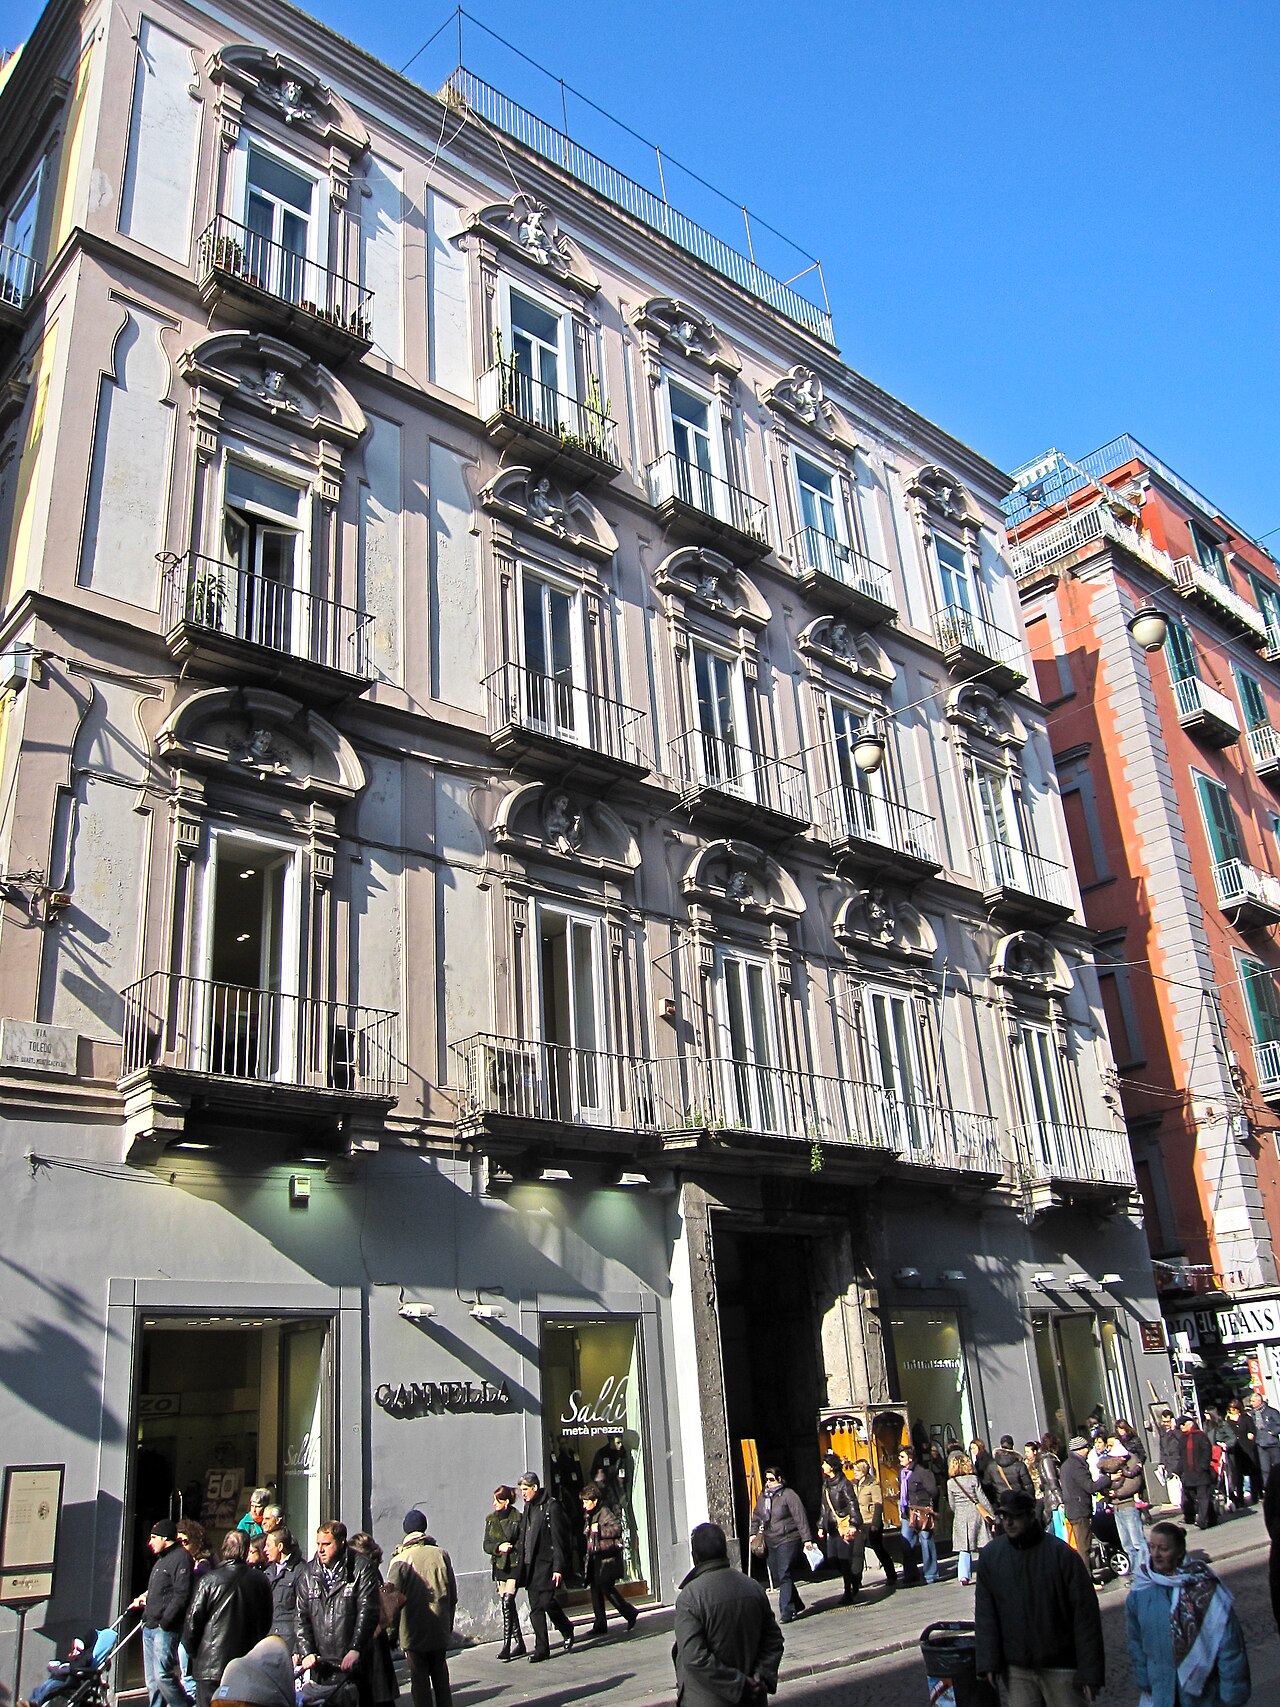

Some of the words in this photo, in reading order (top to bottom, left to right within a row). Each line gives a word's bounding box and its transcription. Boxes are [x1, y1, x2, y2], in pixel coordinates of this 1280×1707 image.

[36, 1028, 47, 1037] VIA
[29, 1041, 52, 1053] TOLEDO
[1220, 1308, 1275, 1336] JEANS
[375, 1380, 511, 1408] CANNELLA
[560, 1375, 629, 1424] Saldi
[562, 1424, 589, 1436] metà
[590, 1426, 624, 1437] prezzo
[207, 1474, 235, 1499] 50
